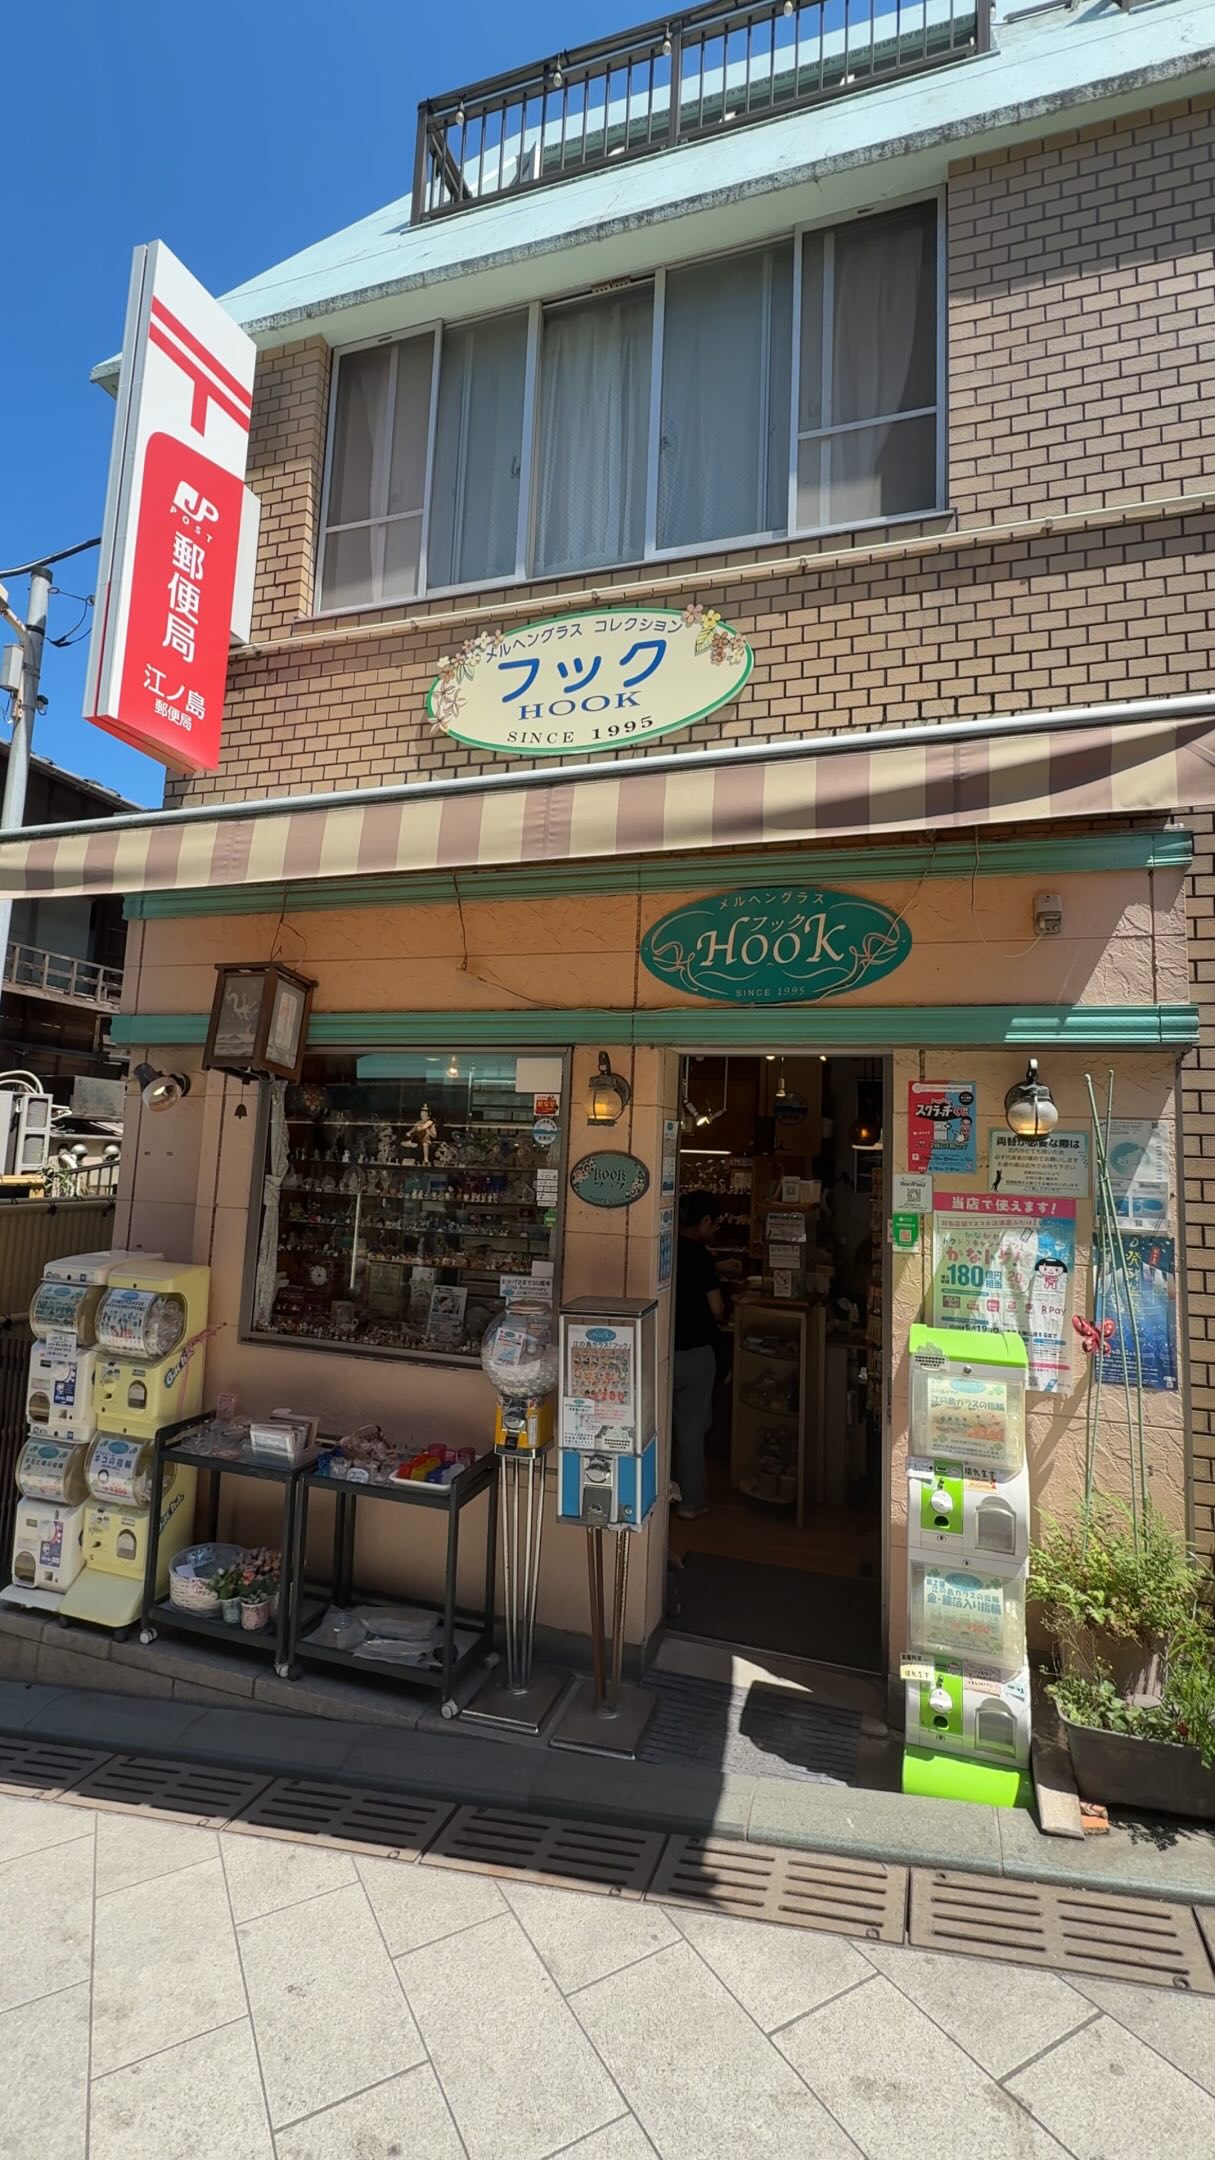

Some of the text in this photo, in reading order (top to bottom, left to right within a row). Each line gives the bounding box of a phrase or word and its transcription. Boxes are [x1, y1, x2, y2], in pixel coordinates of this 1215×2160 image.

[169, 505, 213, 544] POST
[162, 531, 205, 664] 郵便局
[486, 617, 684, 664] メルヘングラス コレクション
[498, 639, 667, 703] フック
[143, 663, 206, 721] 江ノ島
[518, 691, 642, 721] HOOK
[154, 697, 193, 732] 郵便局
[507, 715, 654, 744] SINCE 1995
[719, 891, 825, 911] メルヘングラス
[750, 913, 806, 933] フック
[735, 986, 806, 998] SINCE 1995
[916, 1104, 969, 1117] スクラッチくじ
[952, 1196, 1057, 1215] 当店で使えます！
[947, 1263, 985, 1288] 180
[1048, 1305, 1067, 1315] Pay
